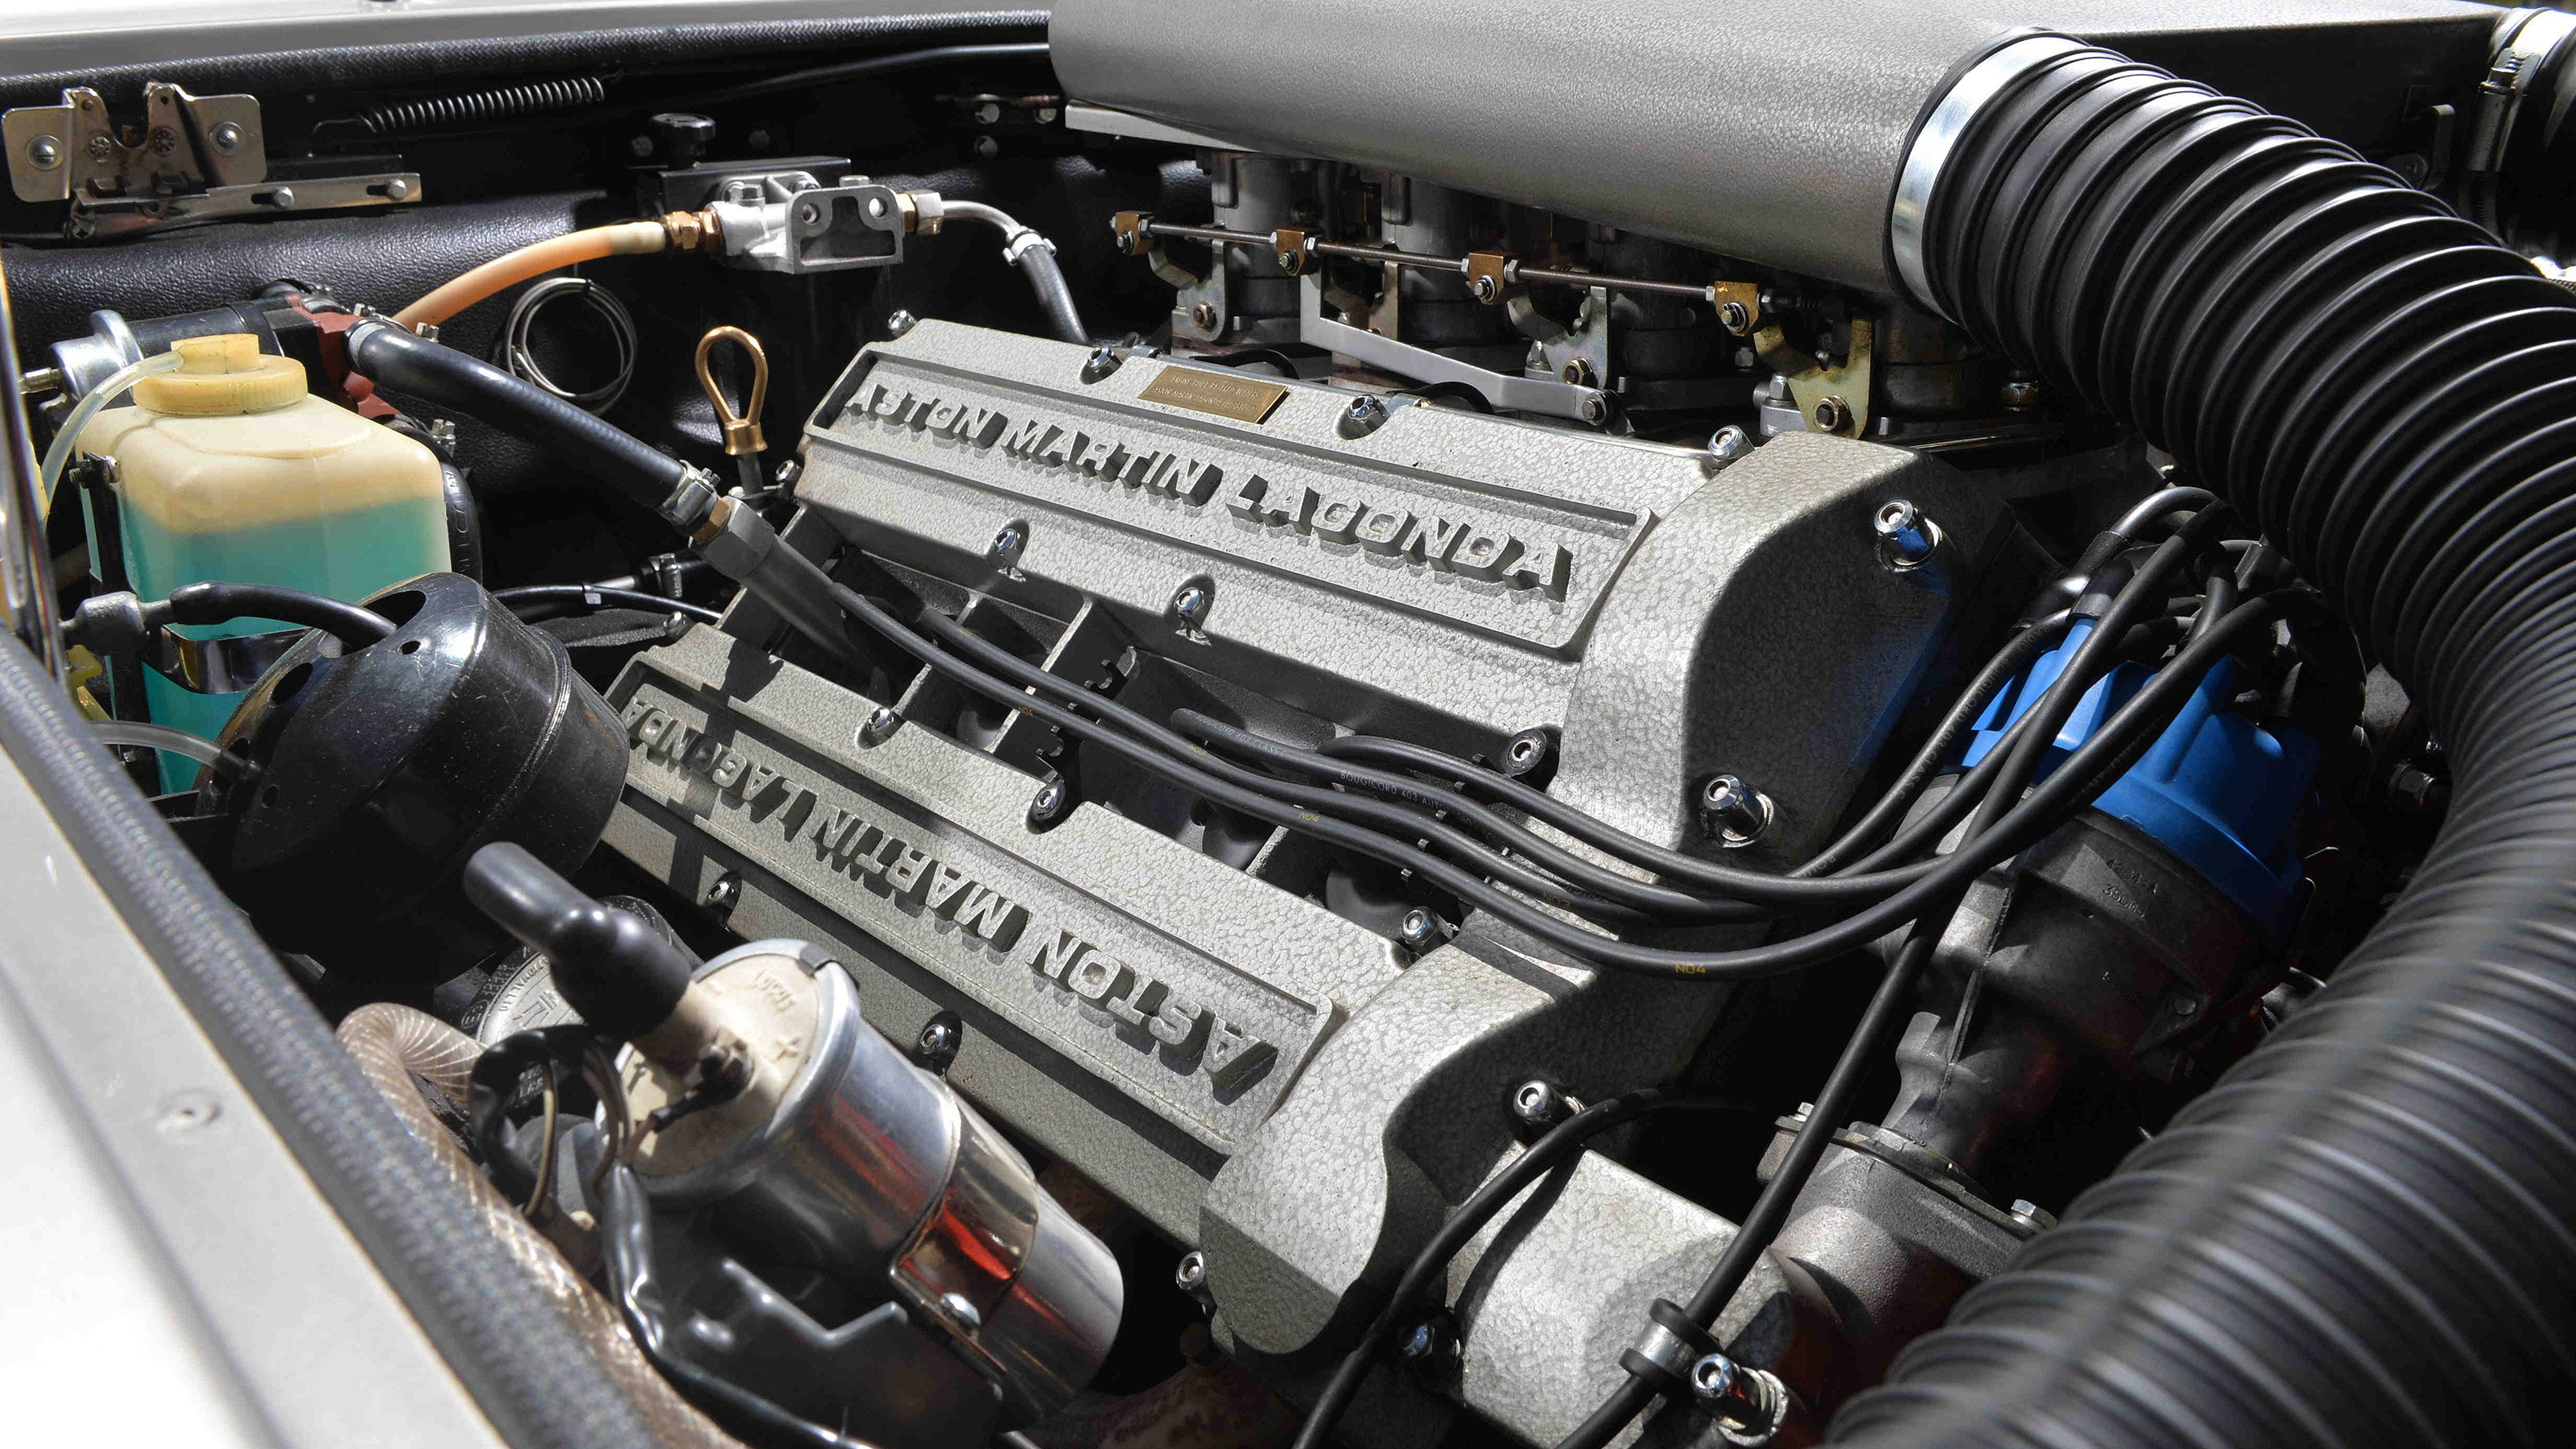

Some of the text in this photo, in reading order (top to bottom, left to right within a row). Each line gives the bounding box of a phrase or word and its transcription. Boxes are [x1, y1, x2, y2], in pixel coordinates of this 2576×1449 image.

[844, 384, 1573, 601] ASTON MARTIN LAGONDA
[1253, 739, 1279, 755] CLASS
[1340, 769, 1418, 803] BOUGICORD 403
[1906, 750, 1938, 789] CLASS
[621, 696, 1278, 1091] LAGONDA MARTIN ASTON
[1675, 964, 1706, 974] NO4
